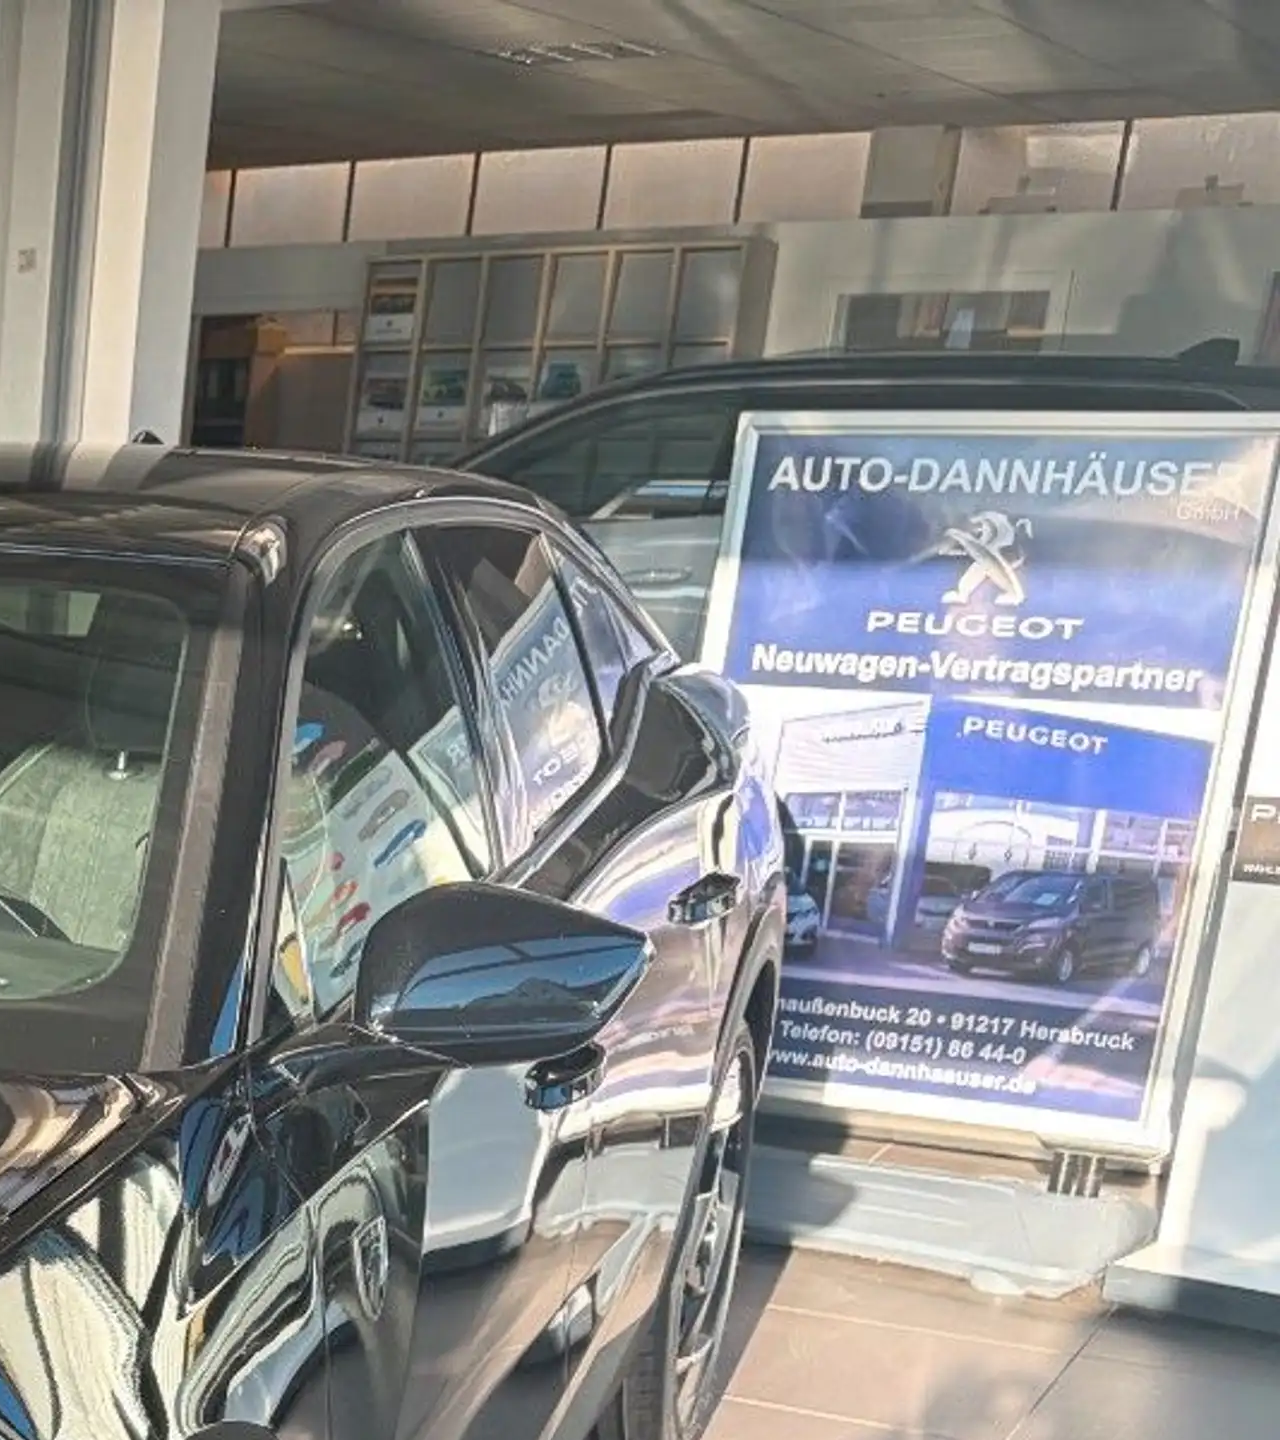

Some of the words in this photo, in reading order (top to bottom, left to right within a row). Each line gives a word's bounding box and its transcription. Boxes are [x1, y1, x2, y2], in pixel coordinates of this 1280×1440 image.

[866, 610, 1086, 641] PEUGEOT
[751, 643, 1203, 693] Neuwagen-Vertragspartner
[963, 716, 1108, 757] PEUGEOT
[781, 1020, 861, 1045] Telefon:
[978, 1043, 1027, 1065] 44-0
[905, 1008, 931, 1027] 20
[950, 1013, 1016, 1036] 91217
[1020, 1019, 1135, 1051] Hersbruck
